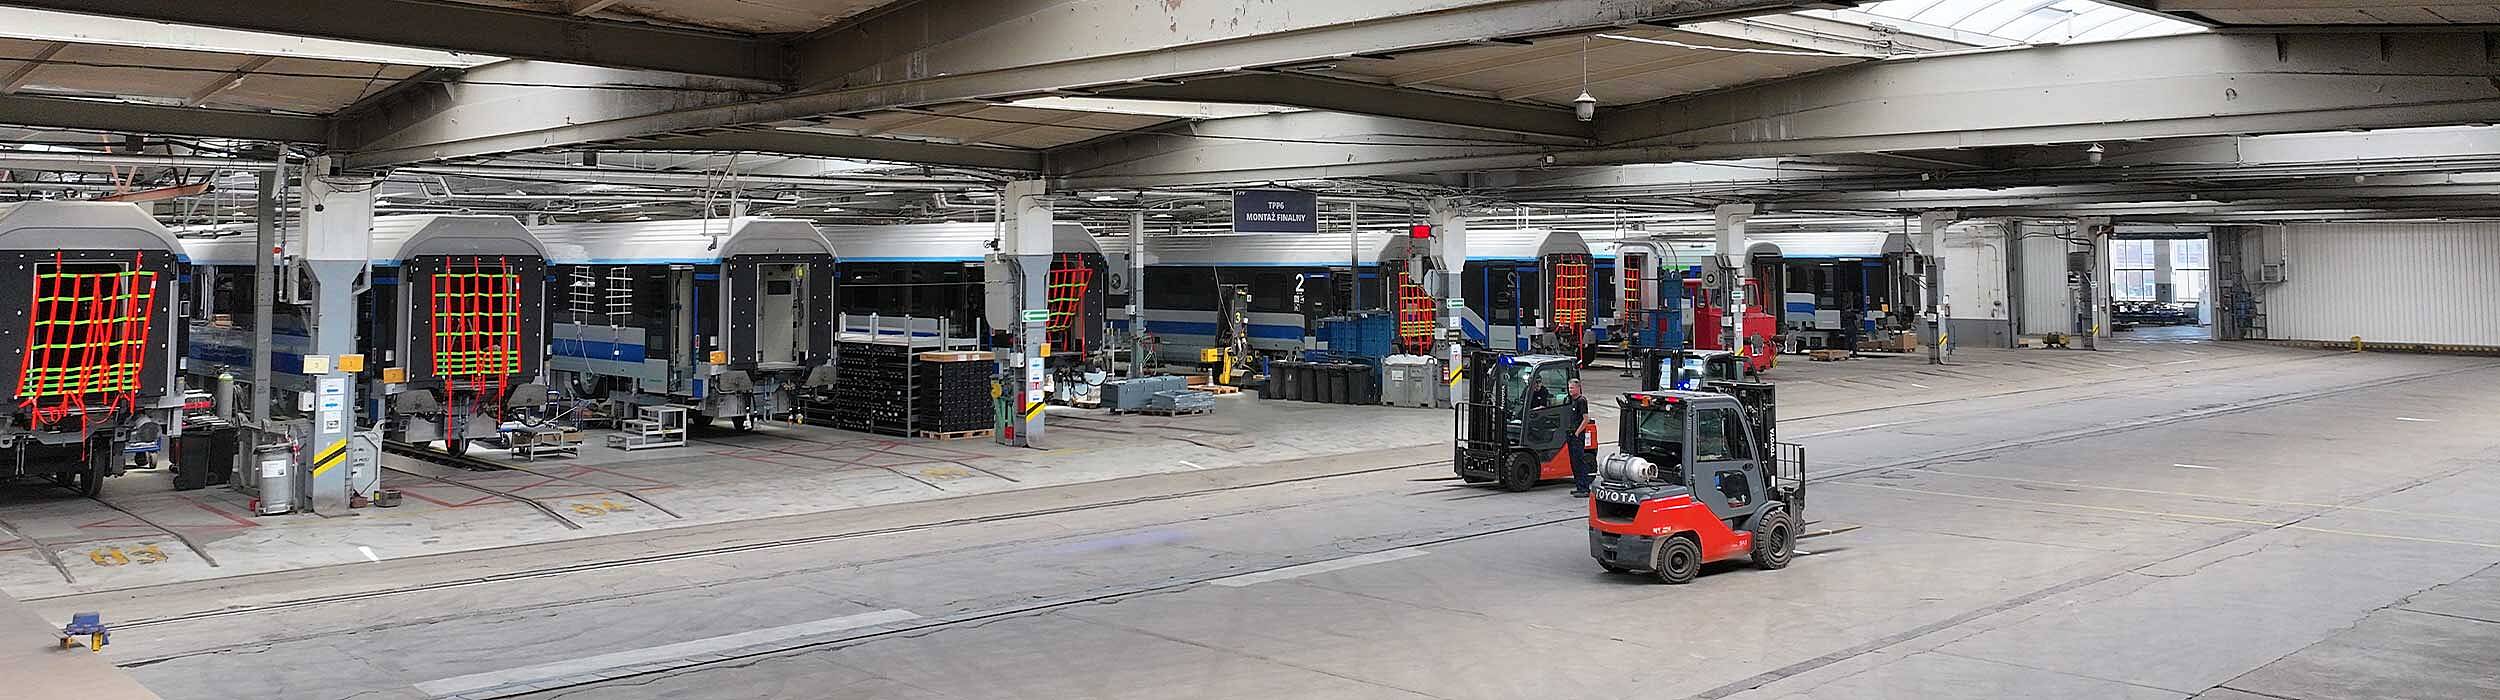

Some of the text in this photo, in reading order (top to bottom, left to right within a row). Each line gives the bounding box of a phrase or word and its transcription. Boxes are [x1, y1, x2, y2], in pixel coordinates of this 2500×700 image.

[1268, 201, 1285, 210] TPP6
[1246, 211, 1306, 222] MONTAŻ FINALNY
[1295, 273, 1305, 292] 2
[1235, 312, 1241, 323] 3
[1596, 489, 1637, 503] TOYOTA
